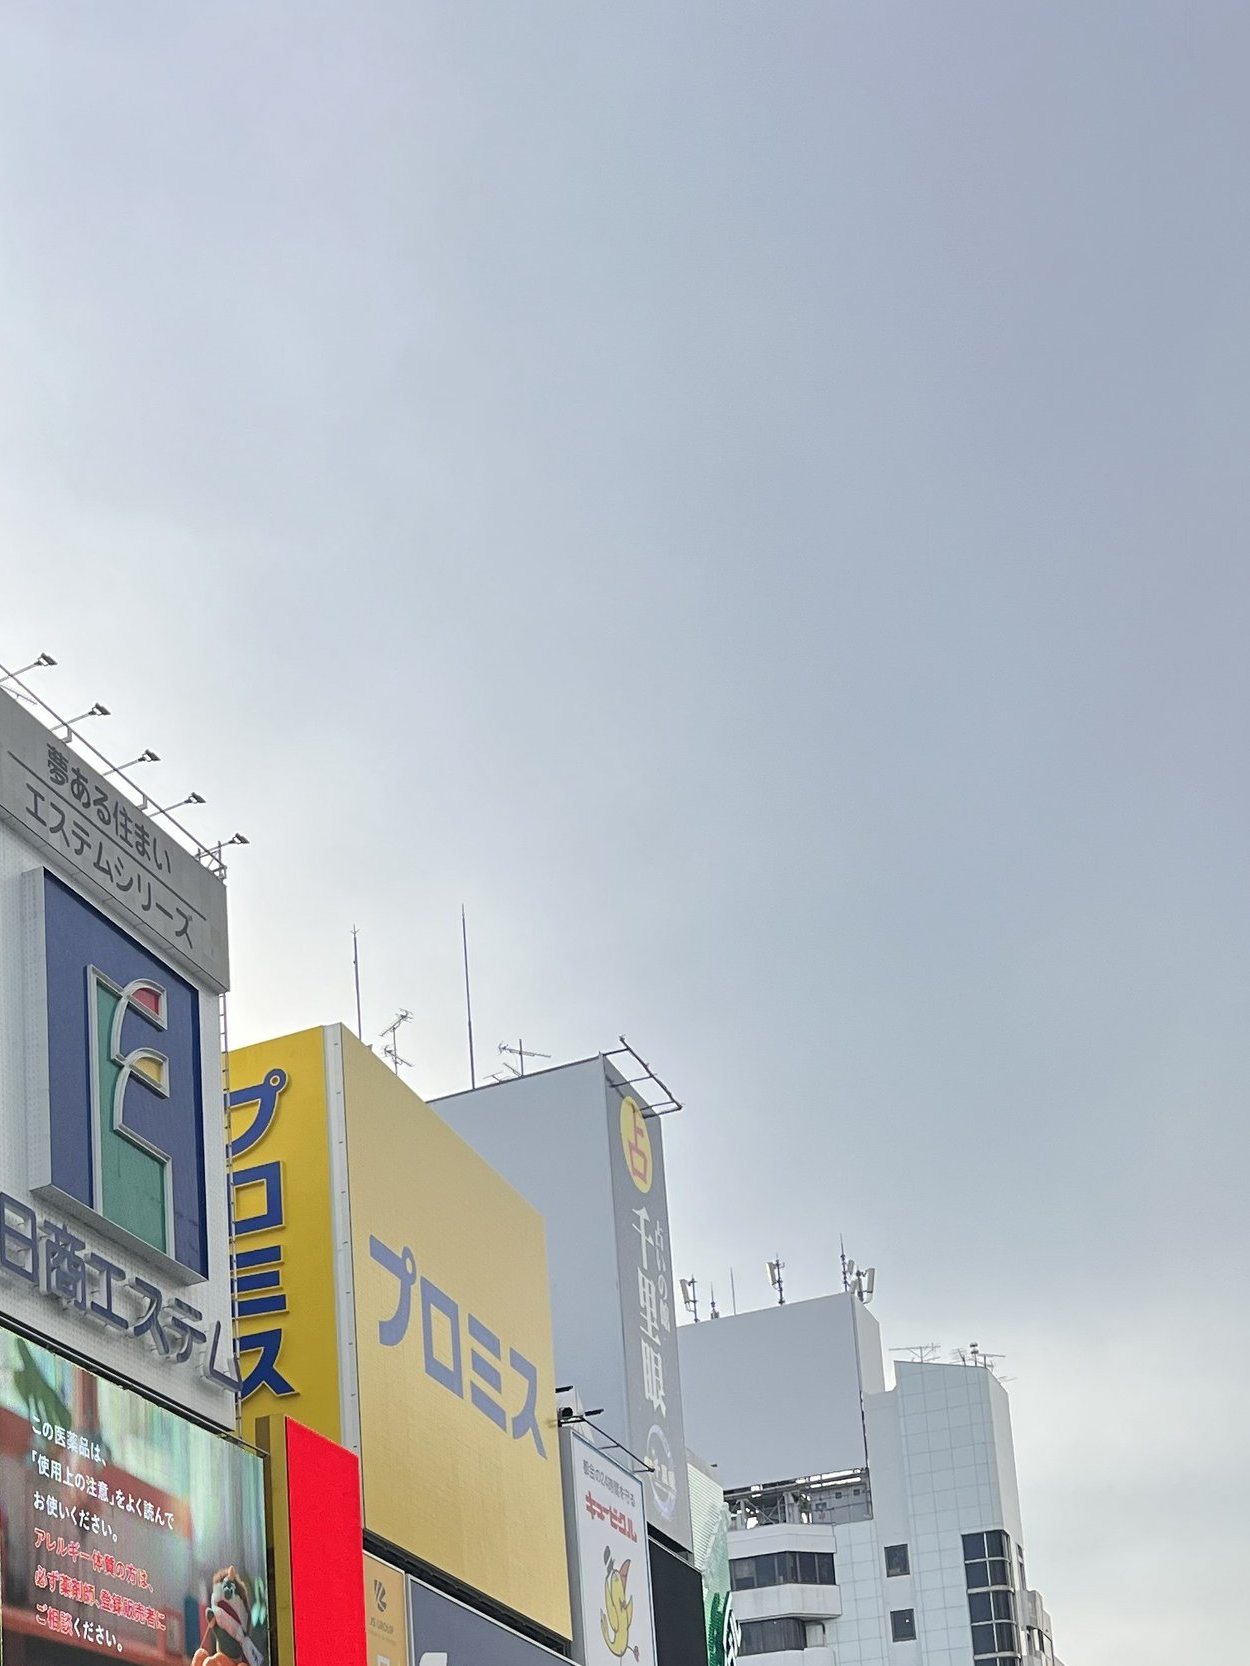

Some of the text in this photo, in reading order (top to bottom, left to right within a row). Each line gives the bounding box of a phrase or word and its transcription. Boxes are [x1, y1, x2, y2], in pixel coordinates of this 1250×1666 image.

[46, 742, 171, 875] 夢ある住まい
[25, 782, 193, 950] エステムシリーズ
[225, 1067, 298, 1400] プロミス
[368, 1234, 548, 1461] プロミス
[31, 1415, 107, 1467] この医薬品は、
[30, 1449, 175, 1531] 「使用上の注意」をよく読んで
[33, 1490, 118, 1543] お使いください。
[33, 1526, 154, 1594] アレルギー体質の方は、
[35, 1603, 123, 1653] ご相談ください。
